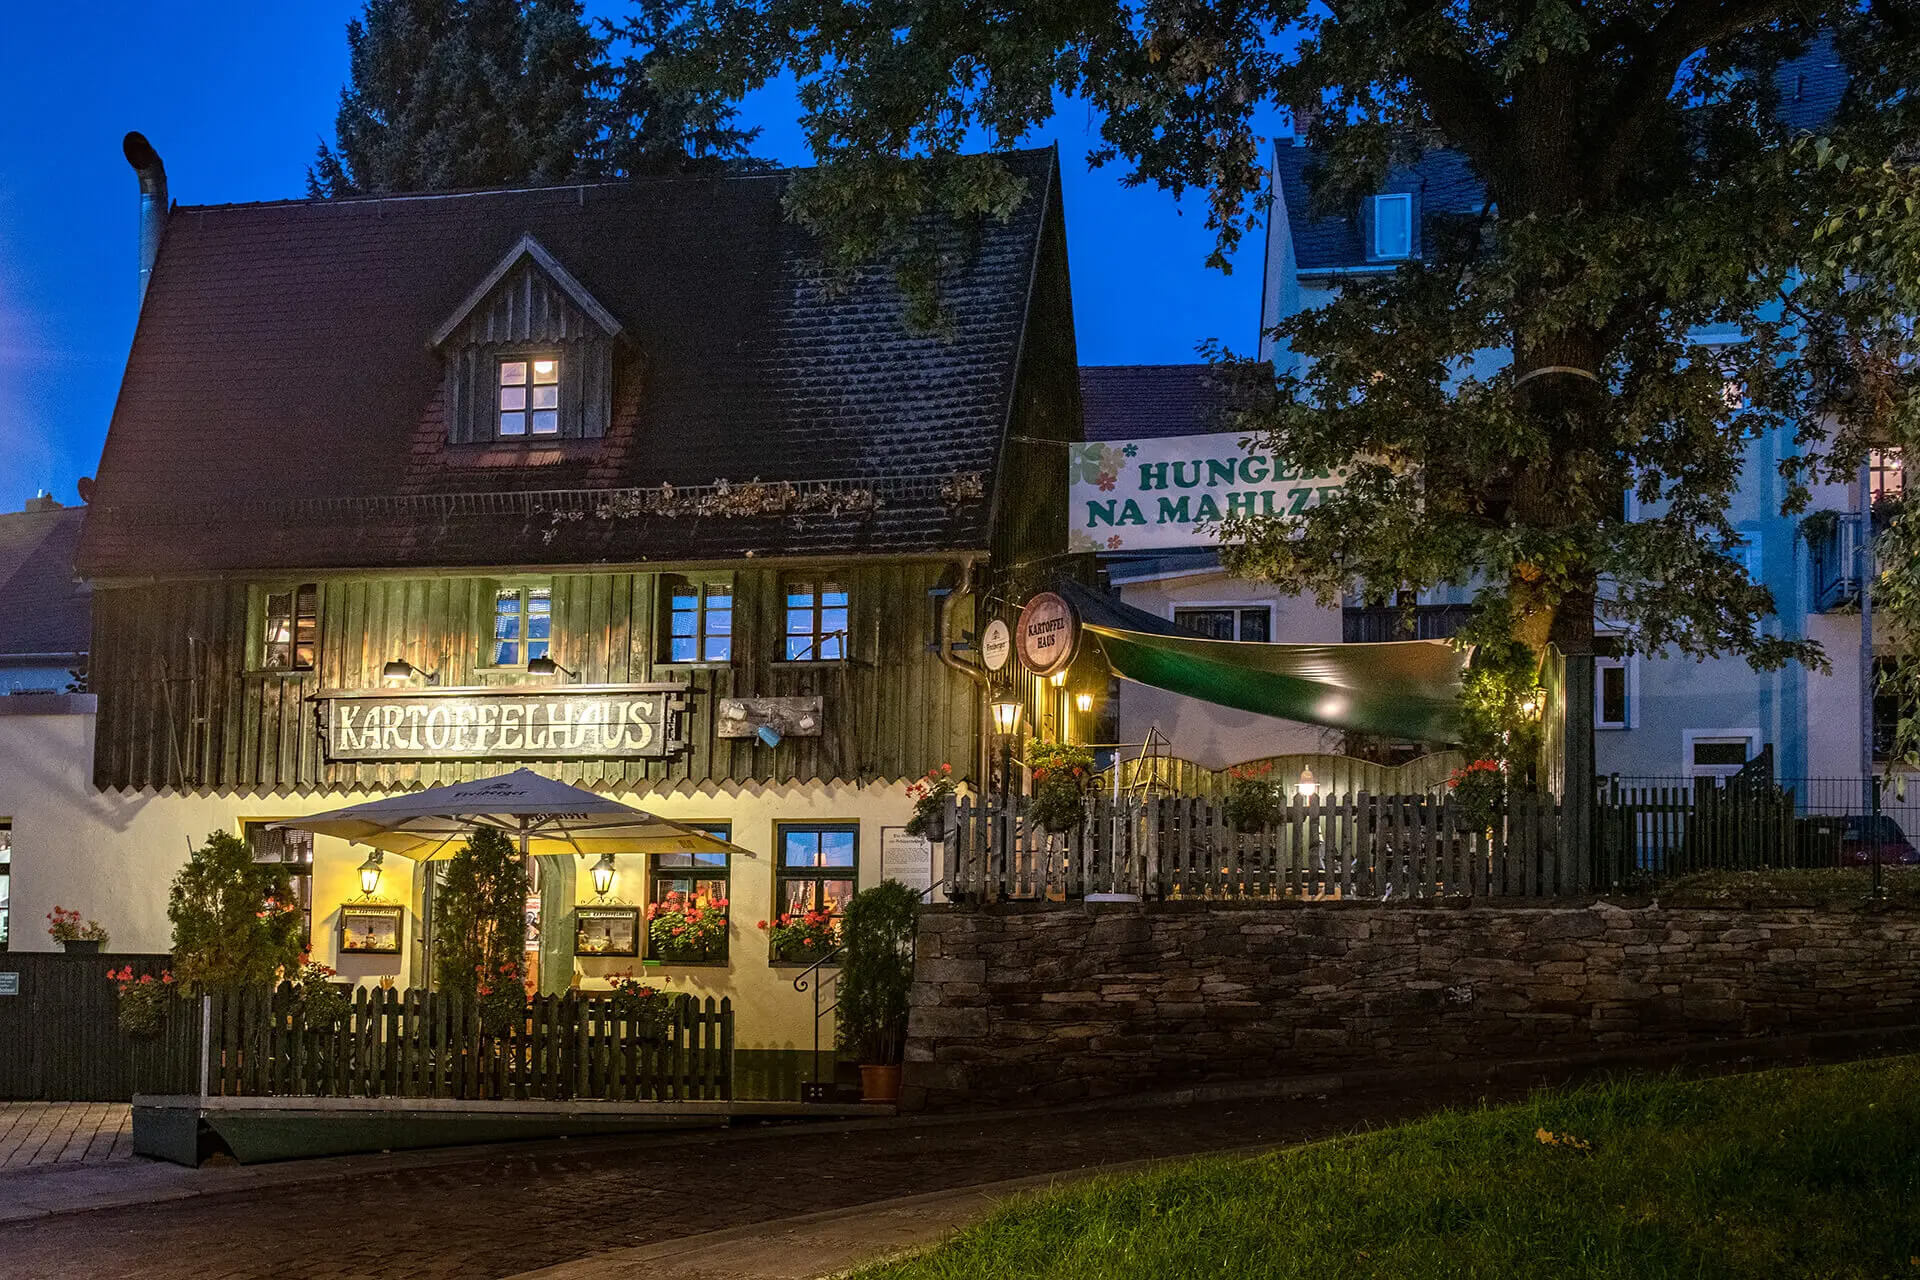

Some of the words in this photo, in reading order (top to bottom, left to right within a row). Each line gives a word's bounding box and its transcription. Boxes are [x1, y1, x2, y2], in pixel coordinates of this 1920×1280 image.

[1138, 454, 1347, 491] HUNGE
[1086, 498, 1148, 528] NA
[1028, 617, 1065, 637] KARTOFFEL
[1037, 634, 1056, 649] HAUS
[338, 701, 653, 751] KARTOFFELHAUS
